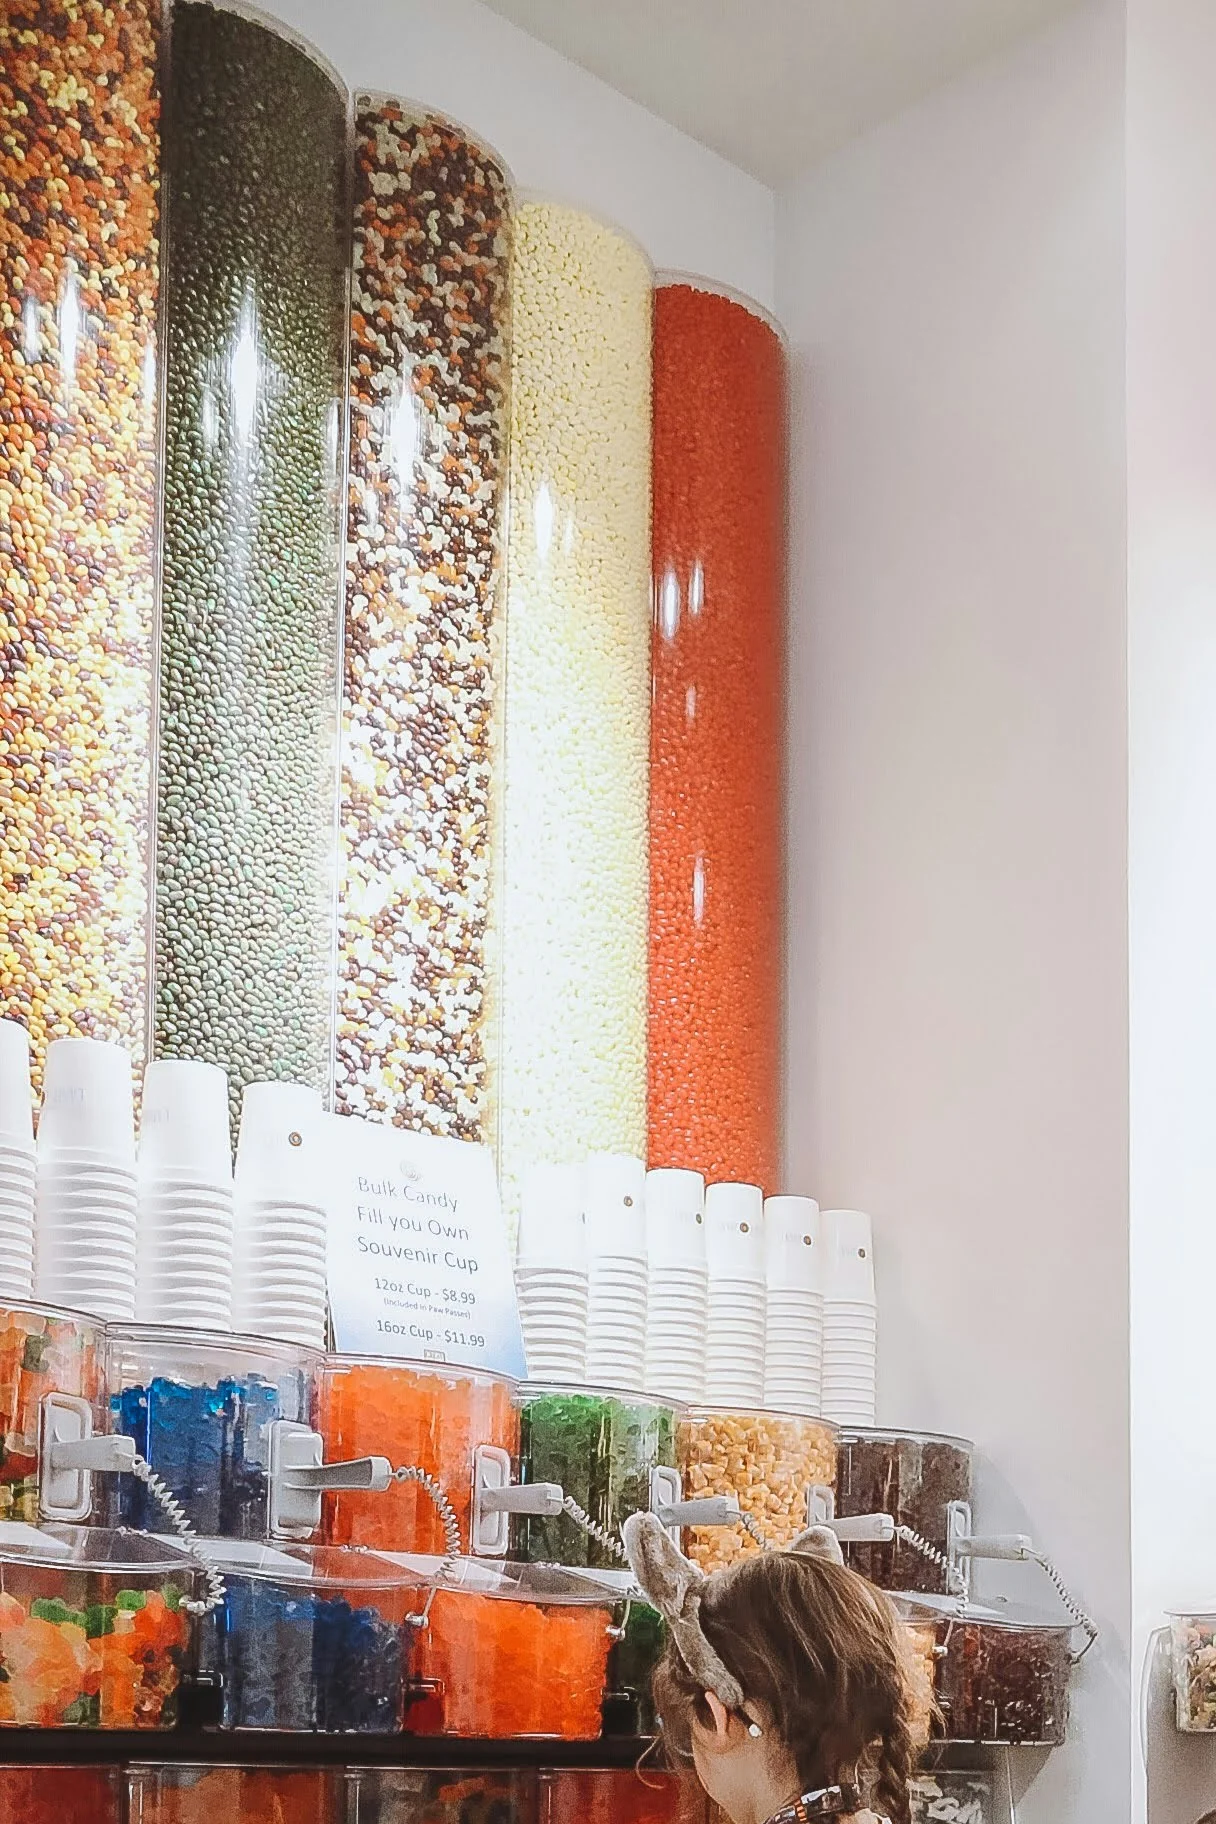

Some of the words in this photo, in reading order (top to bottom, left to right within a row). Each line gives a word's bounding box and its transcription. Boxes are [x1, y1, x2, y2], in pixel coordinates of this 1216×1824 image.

[358, 1176, 397, 1197] Bulk
[403, 1185, 458, 1212] Candy
[357, 1205, 383, 1225] Fill
[388, 1215, 422, 1232] you
[427, 1219, 469, 1241] Own
[357, 1235, 438, 1264] Souvenir
[444, 1252, 479, 1274] Cup
[374, 1277, 404, 1293] 12oz
[407, 1284, 431, 1299] Cup
[442, 1289, 476, 1305] $8.99
[445, 1306, 471, 1319] Passes)
[376, 1320, 407, 1336] 16oz
[409, 1325, 433, 1341] Cup
[444, 1329, 485, 1347] $11.99
